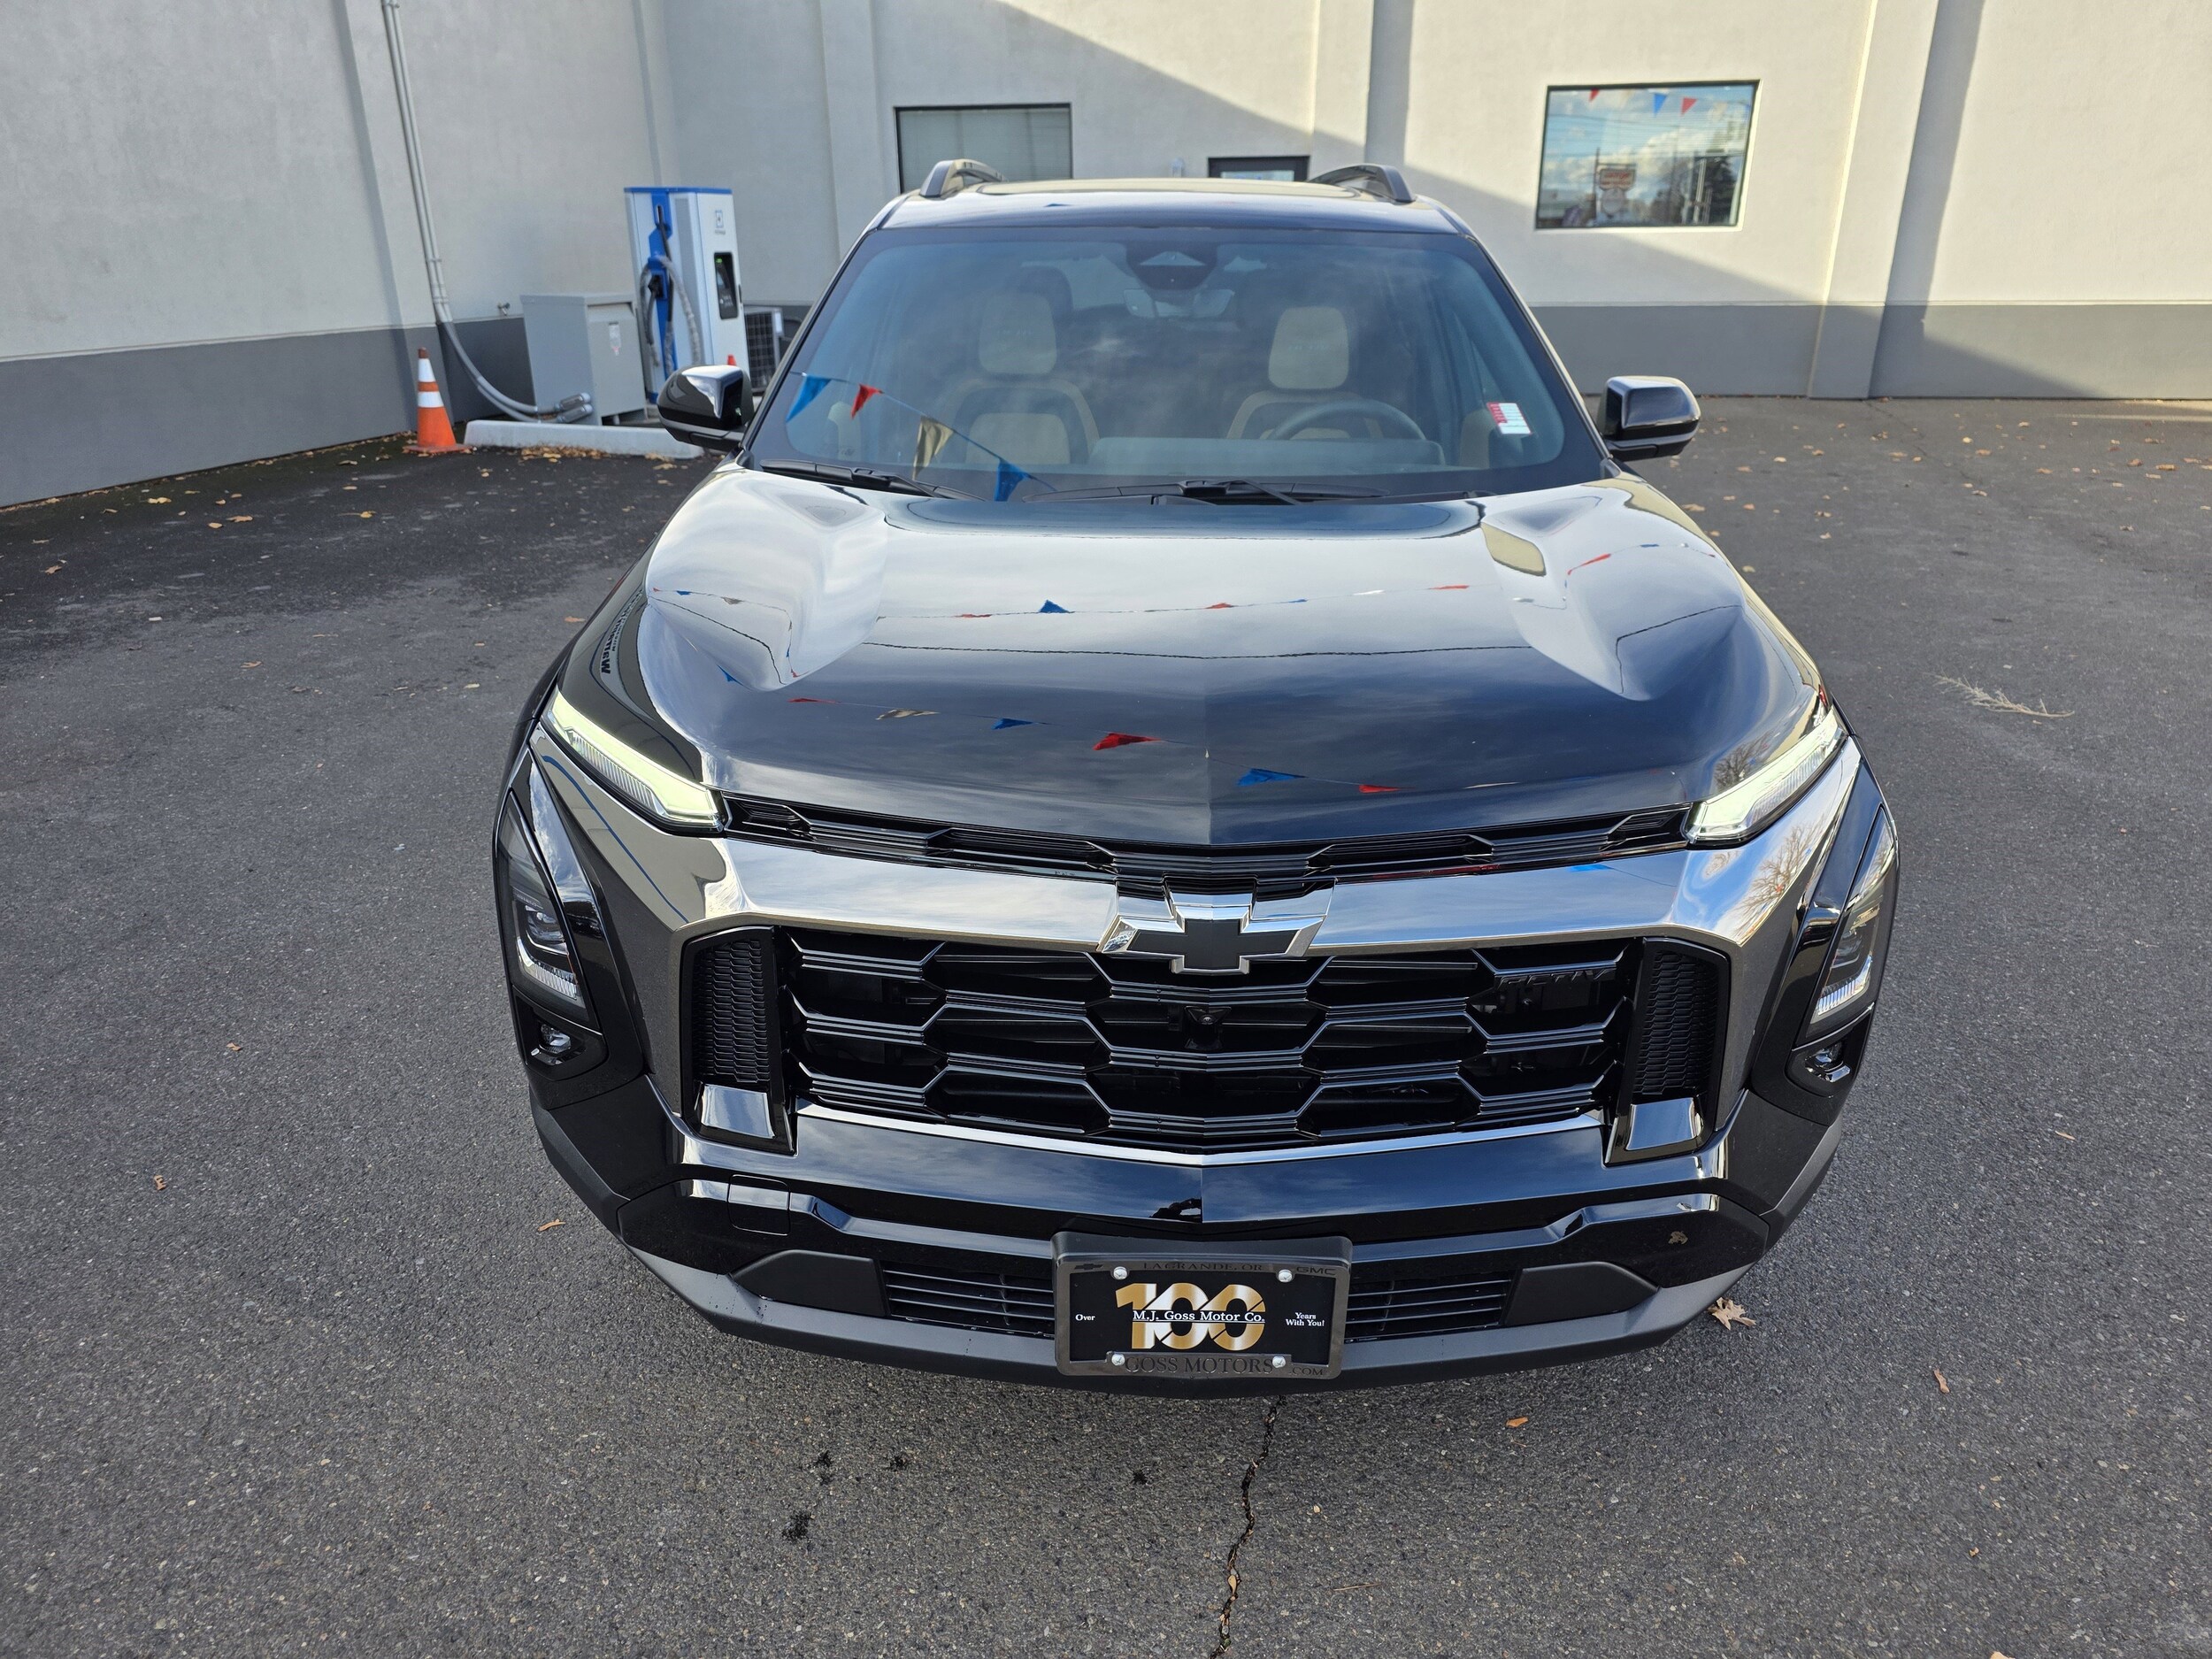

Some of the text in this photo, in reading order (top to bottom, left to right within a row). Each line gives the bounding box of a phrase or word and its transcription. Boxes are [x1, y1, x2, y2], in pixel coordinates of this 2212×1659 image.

[1241, 1263, 1263, 1271] OR
[1296, 1265, 1337, 1276] GMC
[1075, 1313, 1096, 1322] Over
[1115, 1282, 1266, 1351] 100
[1133, 1310, 1265, 1323] M.J. Goss Motor Co.
[1294, 1311, 1317, 1320] Years
[1307, 1318, 1325, 1327] You!
[1125, 1356, 1274, 1375] GOSS MOTORS
